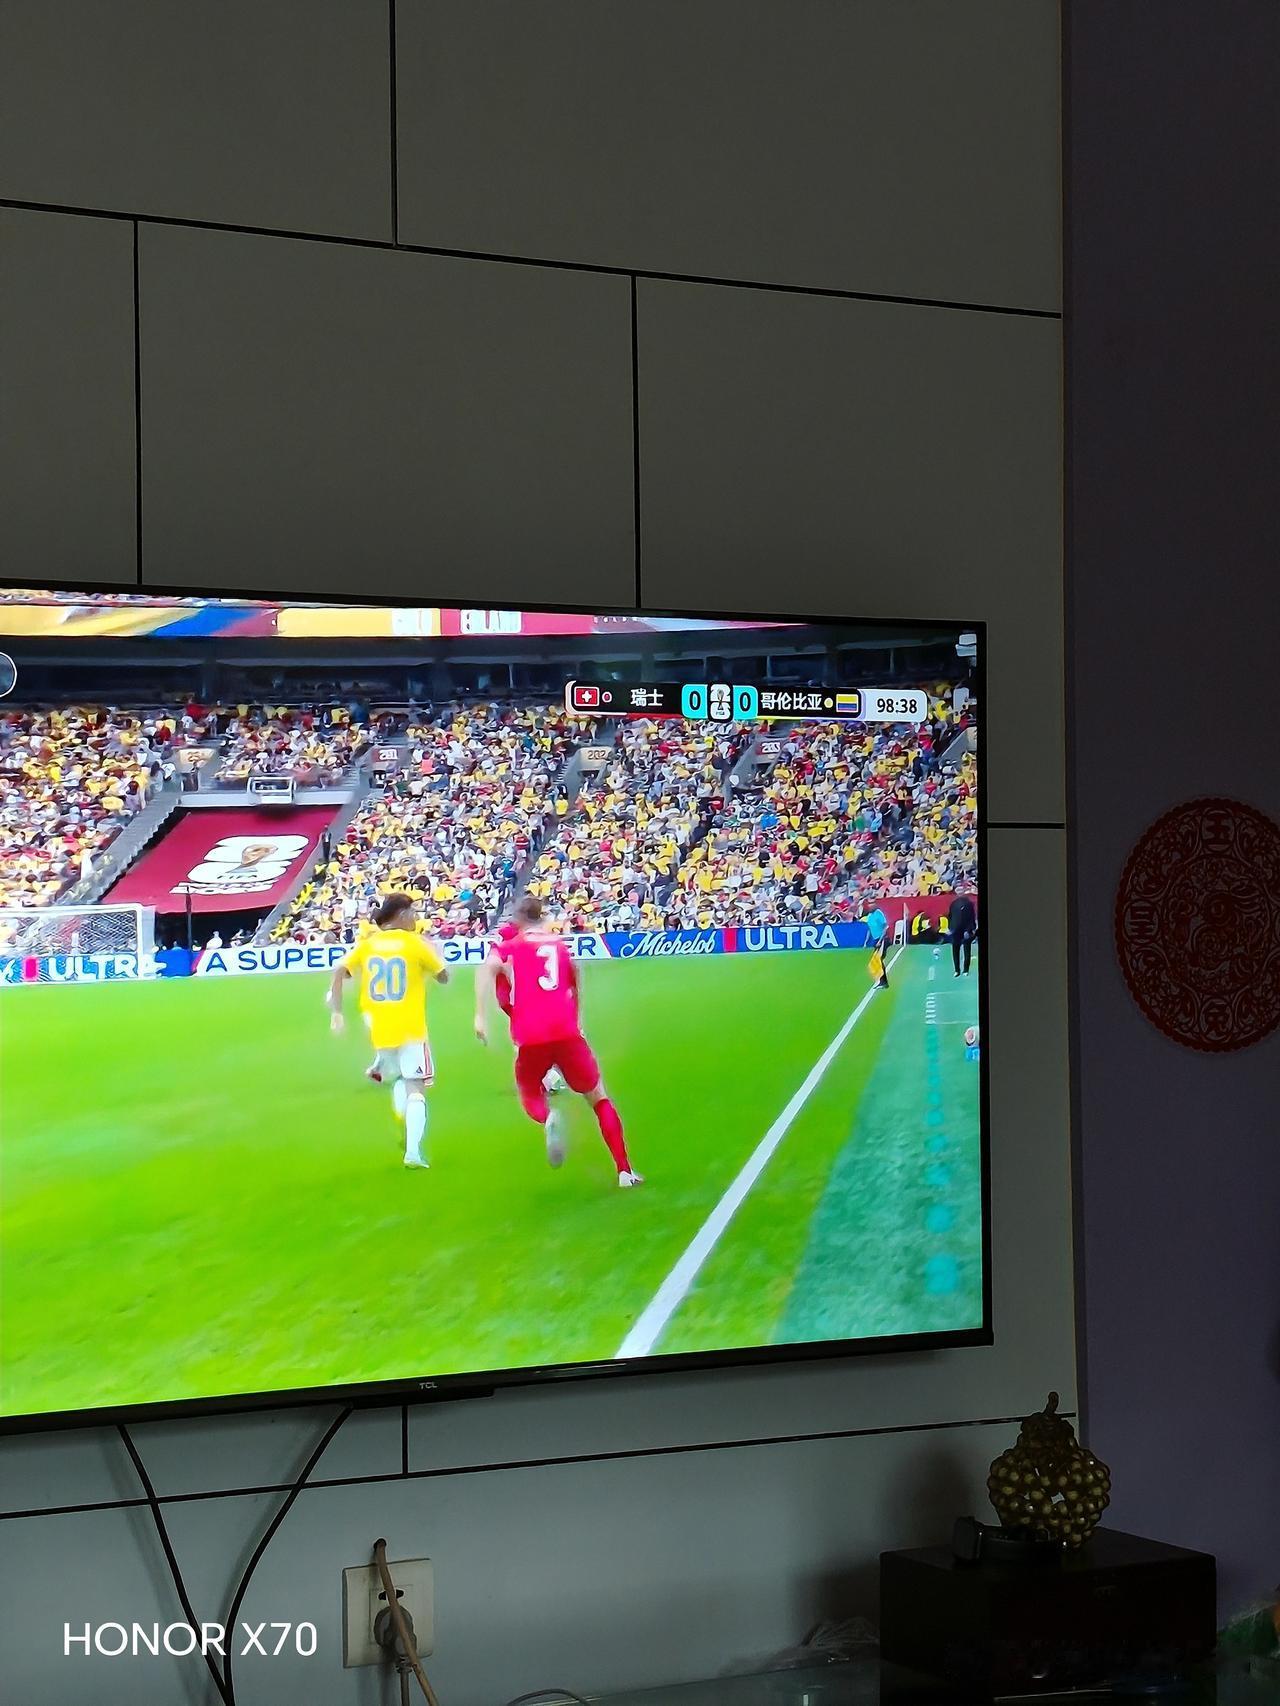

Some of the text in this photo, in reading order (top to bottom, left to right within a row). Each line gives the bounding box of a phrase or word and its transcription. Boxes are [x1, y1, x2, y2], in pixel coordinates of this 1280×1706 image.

[630, 687, 664, 707] 瑞士
[689, 690, 701, 711] 0
[739, 691, 751, 712] 0
[760, 691, 823, 711] 哥伦比亚
[876, 698, 918, 714] 98:38
[620, 924, 839, 958] Michelob ULTRA
[206, 952, 228, 972] A
[536, 944, 560, 991] 3
[368, 956, 407, 1002] 20
[418, 1381, 438, 1390] TCL
